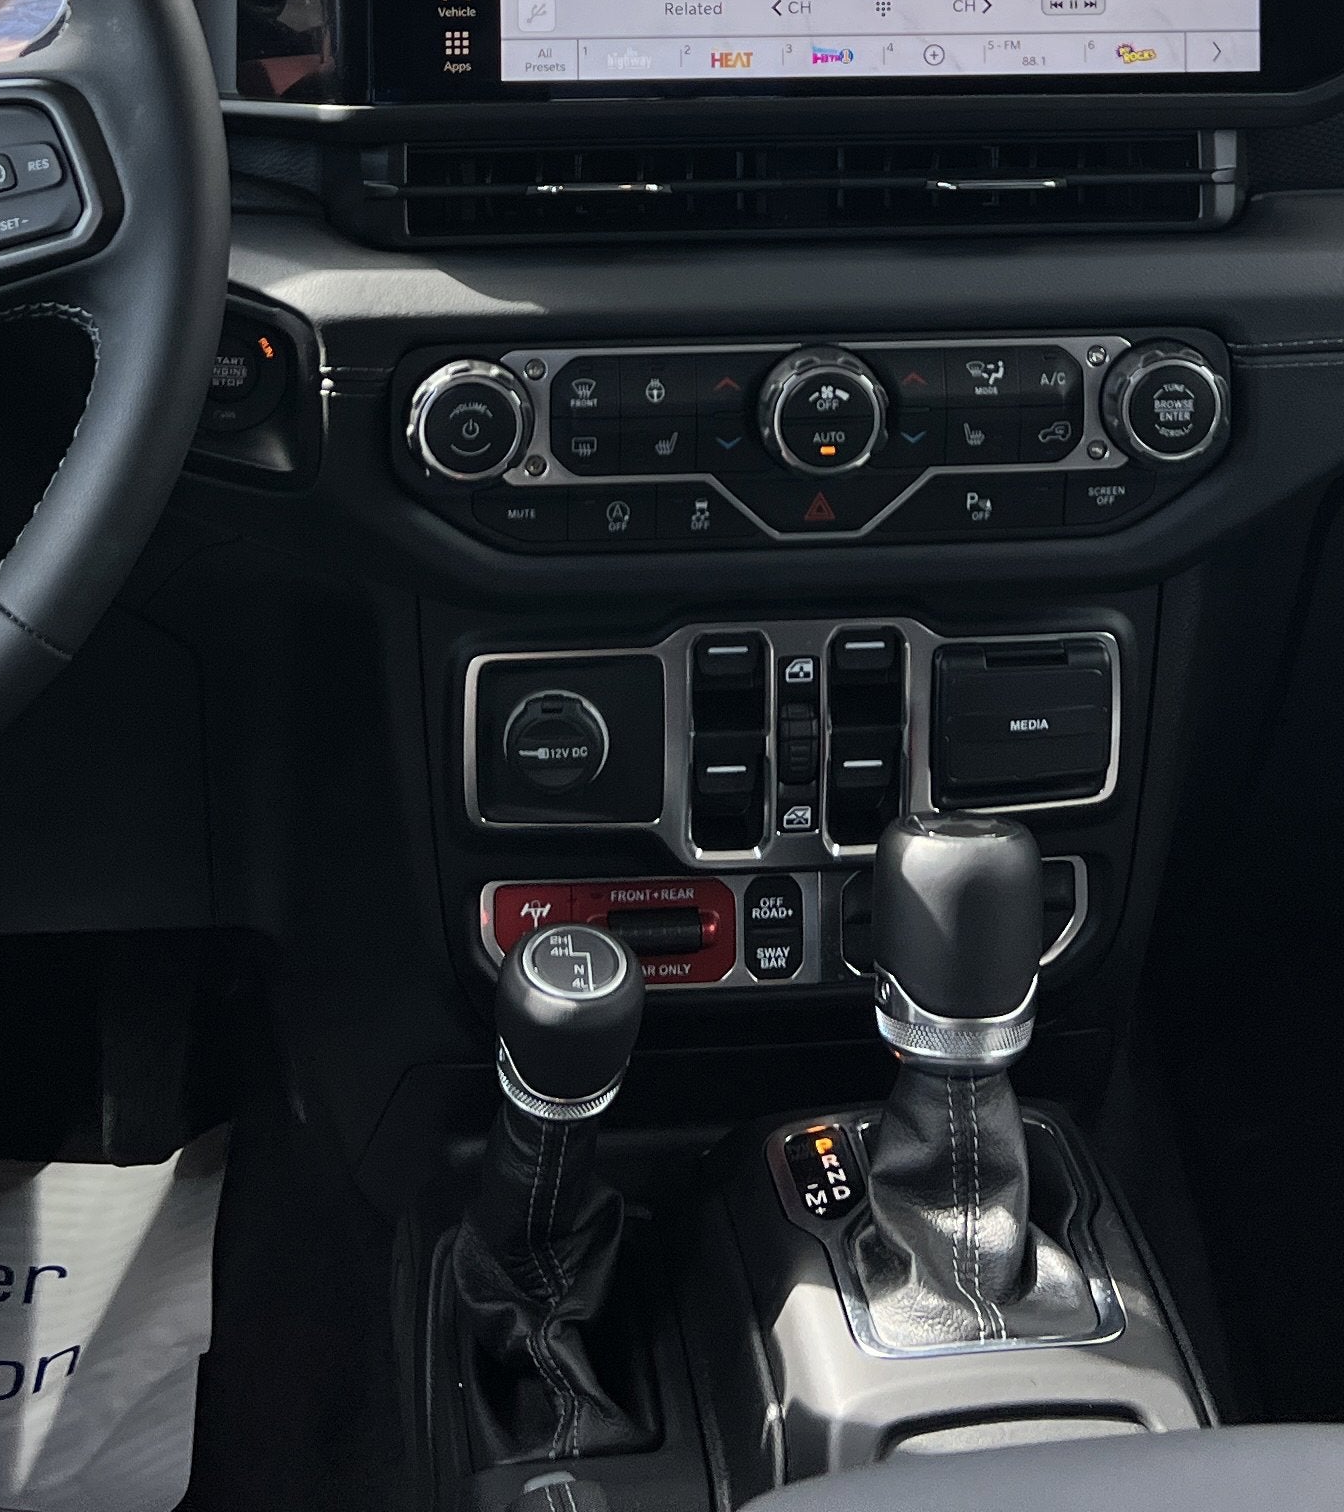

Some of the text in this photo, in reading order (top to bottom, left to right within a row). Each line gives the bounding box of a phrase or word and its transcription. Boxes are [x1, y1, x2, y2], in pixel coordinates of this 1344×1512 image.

[438, 6, 476, 18] Vehicle
[664, 1, 723, 16] Related
[788, 1, 812, 16] CH
[952, 0, 976, 14] CH
[684, 45, 691, 55] 2
[785, 44, 792, 53] 3
[886, 43, 894, 52] 4
[1004, 40, 1021, 50] FM
[1088, 40, 1095, 50] 6
[538, 49, 552, 59] All
[711, 52, 753, 68] HEAT
[443, 61, 471, 74] Apps
[525, 62, 566, 73] Presets
[1022, 57, 1046, 66] 88.1
[27, 158, 50, 172] RES
[216, 356, 245, 365] TART
[1040, 371, 1066, 387] A/C
[974, 386, 999, 396] MODE
[450, 401, 493, 419] VOLUME
[570, 398, 598, 409] FRONT
[817, 399, 840, 412] OFF
[1154, 399, 1195, 412] BROWSE
[1158, 410, 1192, 423] ENTER
[813, 431, 845, 444] AUTO
[1087, 486, 1125, 497] SCREEN
[1096, 494, 1116, 506] OFF
[507, 508, 536, 519] MUTE
[971, 511, 991, 522] OFF
[608, 521, 628, 532] OFF
[691, 520, 711, 530] OFF
[1009, 718, 1049, 732] MEDIA
[549, 745, 589, 760] 12V DC
[759, 897, 784, 909] OFF
[550, 946, 570, 957] 4H
[756, 945, 791, 960] SWAY
[573, 964, 584, 976] N
[659, 963, 692, 977] ONLY
[760, 957, 787, 970] BAR
[815, 1138, 833, 1155] P
[821, 1154, 840, 1169] R
[826, 1168, 847, 1185] N
[805, 1190, 828, 1208] M
[832, 1186, 851, 1201] D
